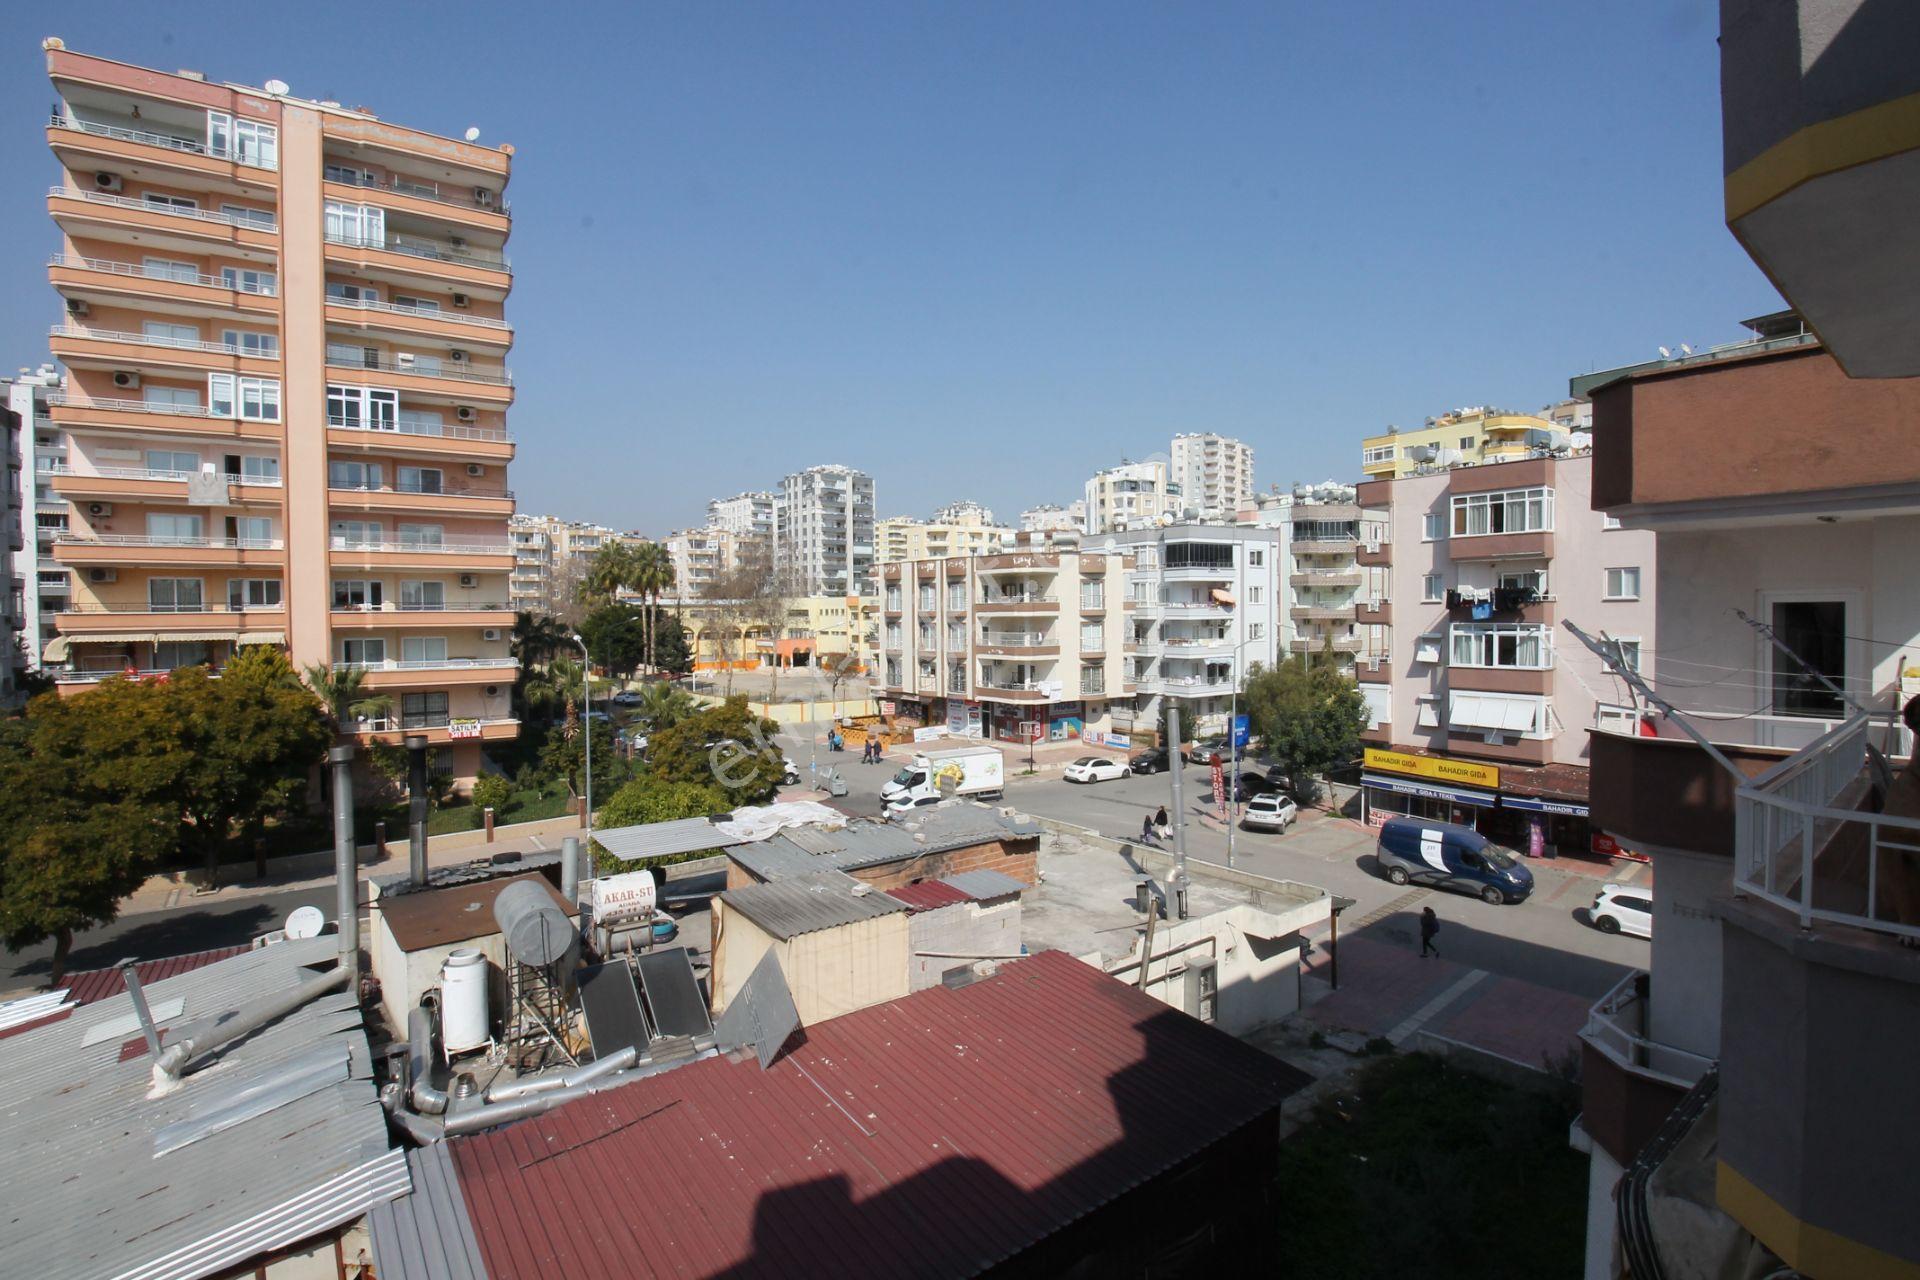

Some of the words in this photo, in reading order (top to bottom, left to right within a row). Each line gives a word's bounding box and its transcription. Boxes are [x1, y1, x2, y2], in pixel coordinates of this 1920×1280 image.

[1373, 755, 1401, 766] BAHADIR
[1401, 759, 1417, 769] GIDA
[1438, 765, 1469, 777] BAHADIR
[1469, 770, 1487, 779] GIDA
[1542, 804, 1573, 814] BAHADIR
